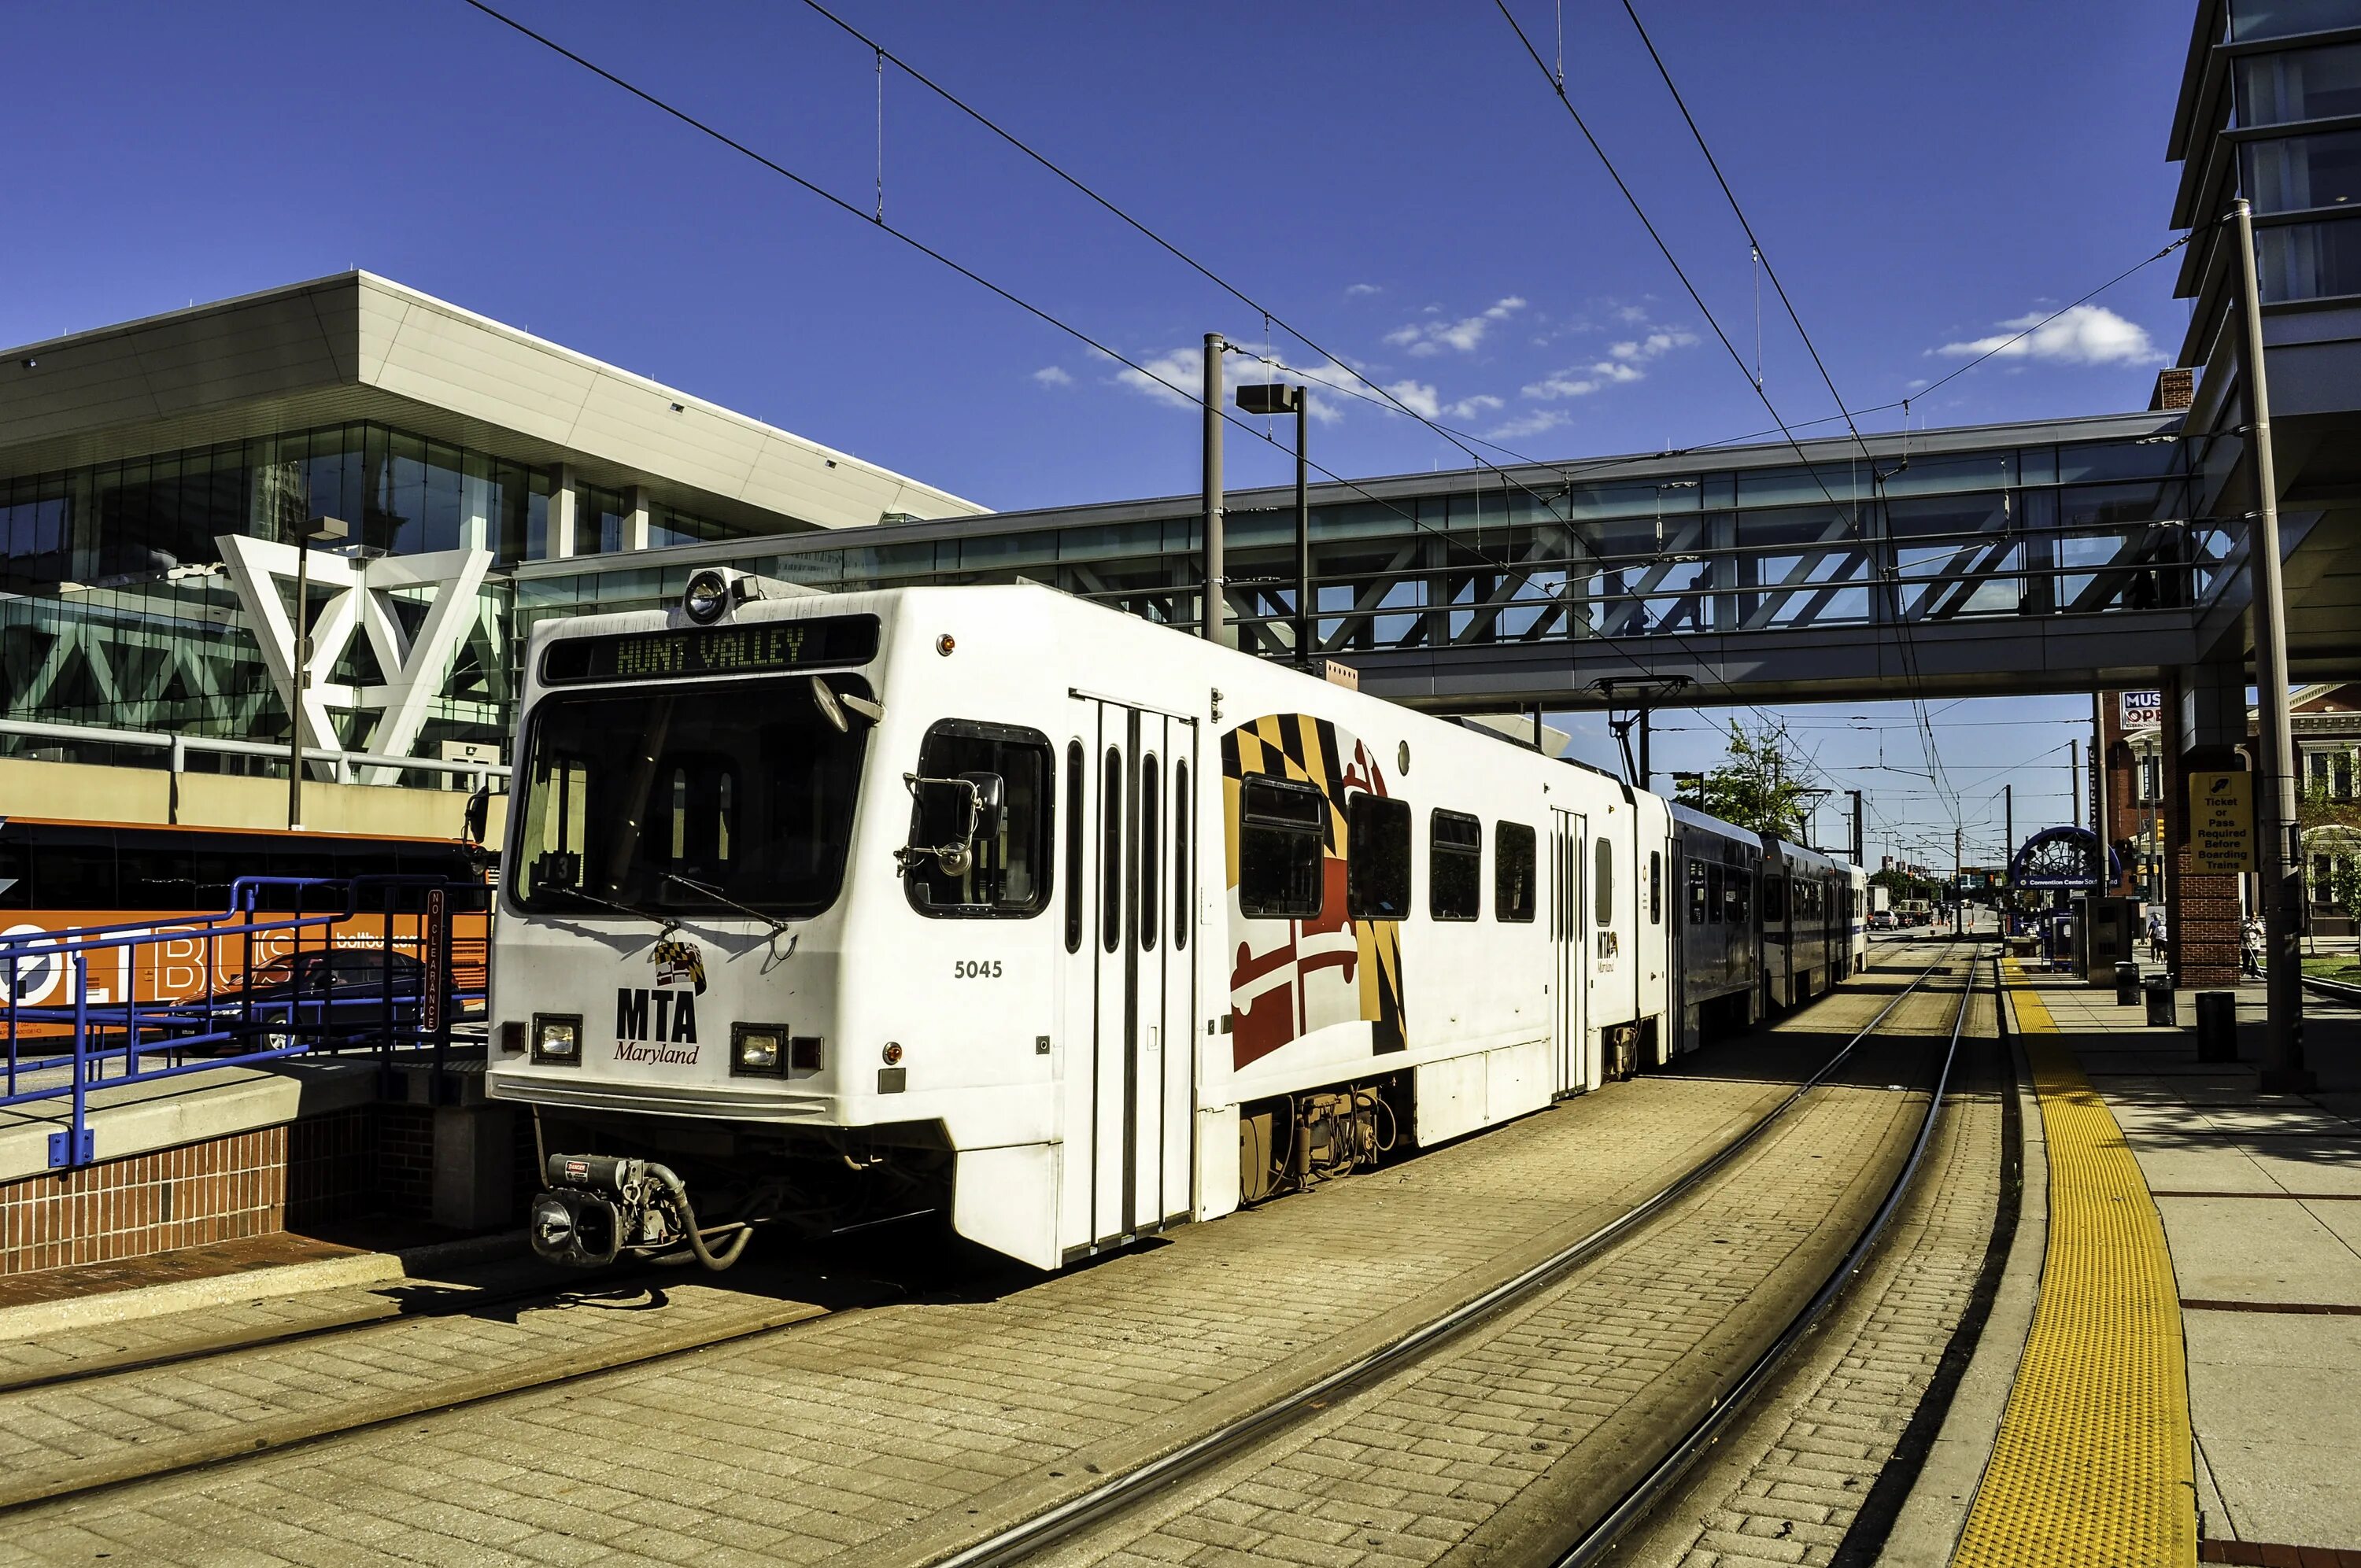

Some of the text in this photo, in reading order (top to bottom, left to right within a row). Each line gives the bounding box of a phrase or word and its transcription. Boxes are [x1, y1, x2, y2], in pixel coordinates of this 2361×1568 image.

[618, 628, 804, 673] HUNT VALLEY
[2204, 798, 2237, 806] Ticket
[2198, 829, 2246, 839] Required
[2198, 850, 2248, 860] Boarding
[2206, 861, 2240, 869] Trains
[429, 893, 438, 1028] NO CLEARANCE
[955, 960, 1003, 979] 5045
[616, 987, 697, 1044] MTA
[613, 1040, 700, 1066] Maryland
